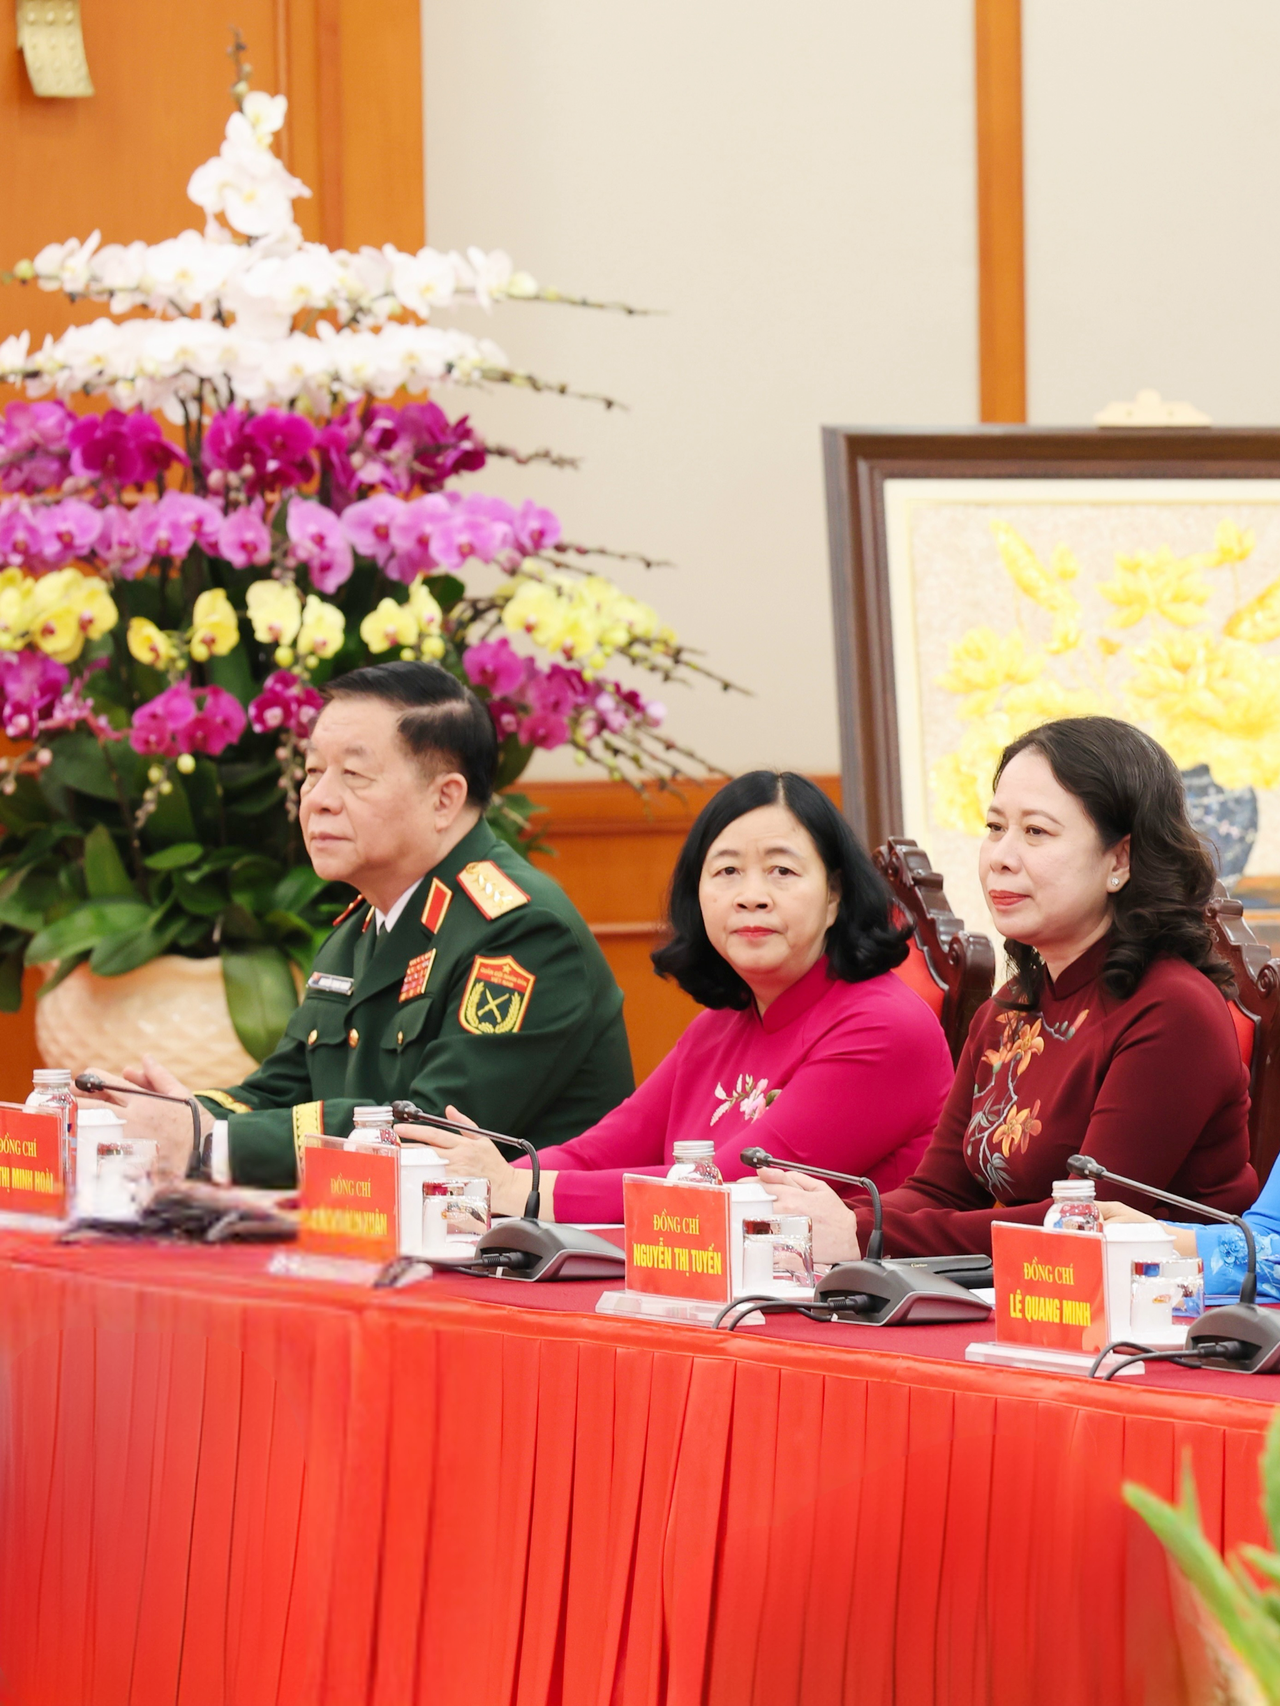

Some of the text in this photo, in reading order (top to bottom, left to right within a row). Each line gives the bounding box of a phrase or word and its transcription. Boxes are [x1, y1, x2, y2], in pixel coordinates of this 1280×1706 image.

[22, 1138, 37, 1158] CHÍ
[12, 1167, 33, 1191] MINH
[330, 1172, 371, 1198] ĐỒNG CHÍ
[363, 1208, 387, 1236] XUÂN
[653, 1208, 700, 1235] ĐỒNG CHÍ
[633, 1237, 722, 1277] NGUYỄN THỊ TUYẾN
[1023, 1256, 1074, 1285] ĐỒNG CHÍ
[1009, 1289, 1091, 1327] LÊ QUANG MINH
